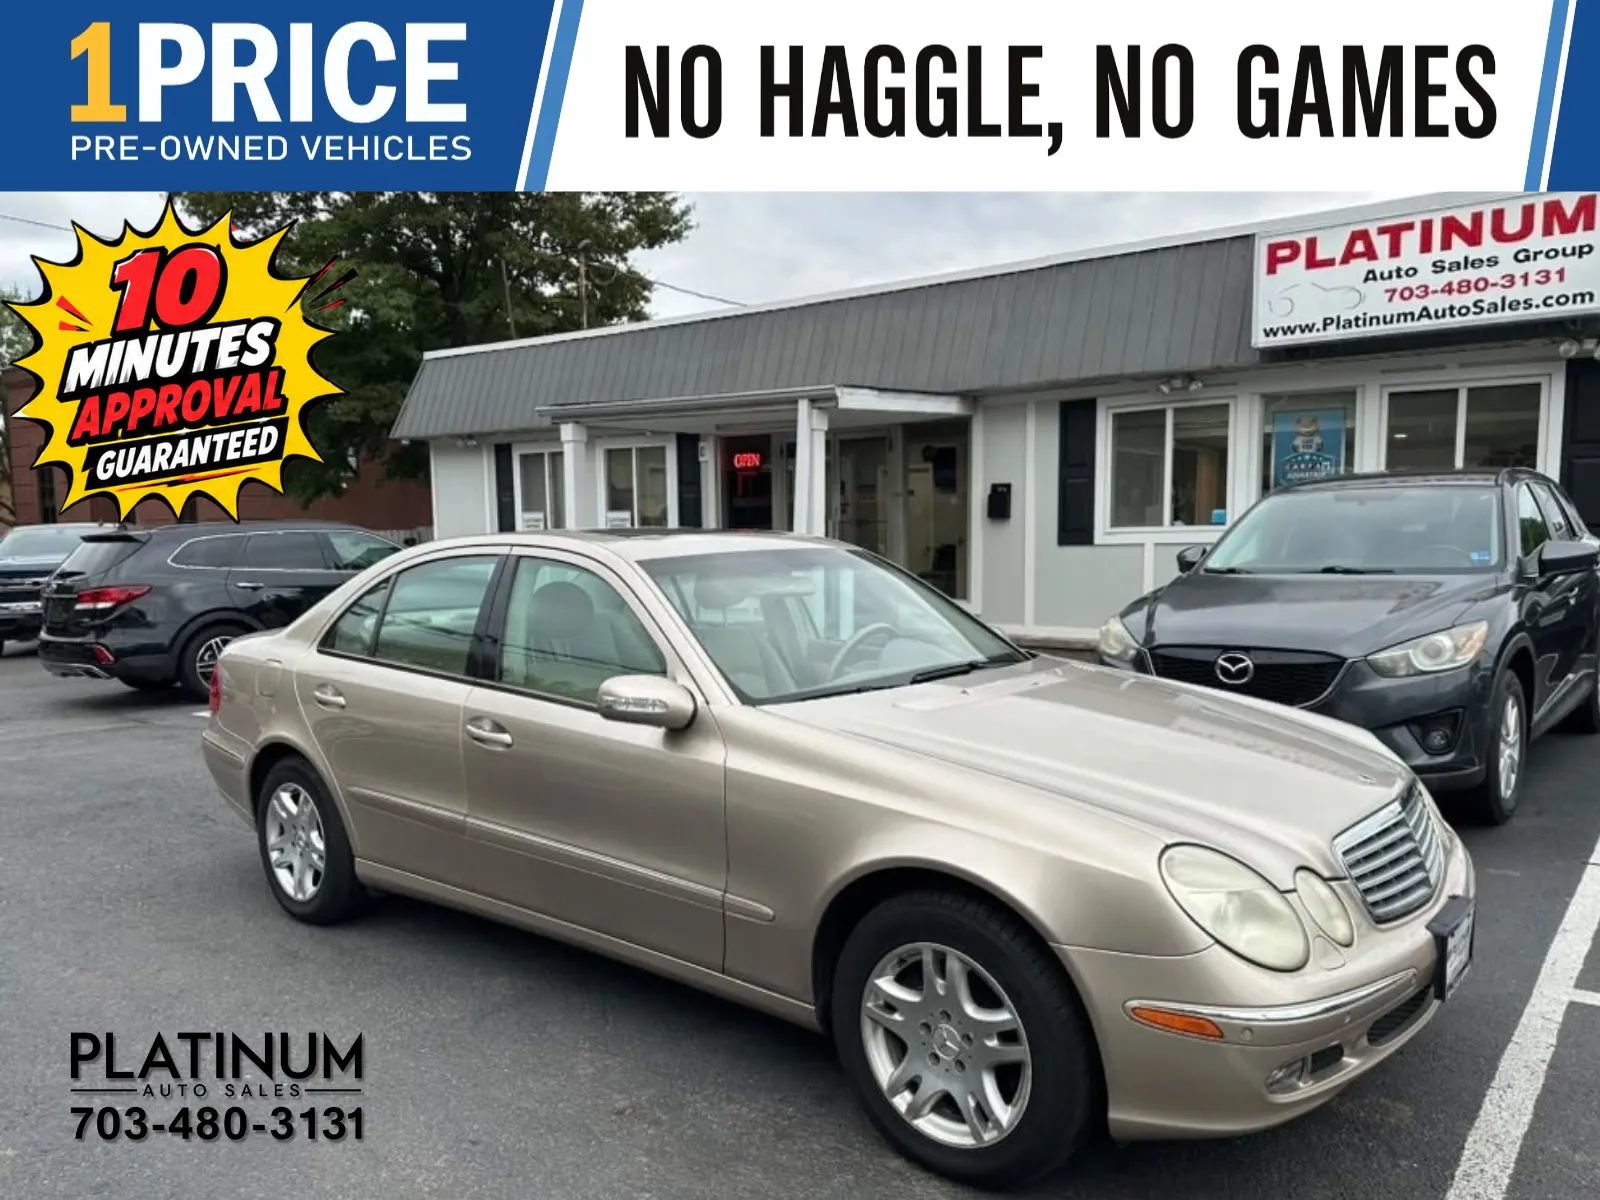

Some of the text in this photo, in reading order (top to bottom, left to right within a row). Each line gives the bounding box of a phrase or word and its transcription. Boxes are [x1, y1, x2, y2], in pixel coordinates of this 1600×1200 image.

[1266, 194, 1597, 275] PLATINUM
[1363, 242, 1594, 284] Auto Sales Group
[1384, 267, 1566, 302] 703-480-3131
[1263, 290, 1594, 338] www.PlatinumAutoSales.com
[734, 453, 760, 468] OPEN
